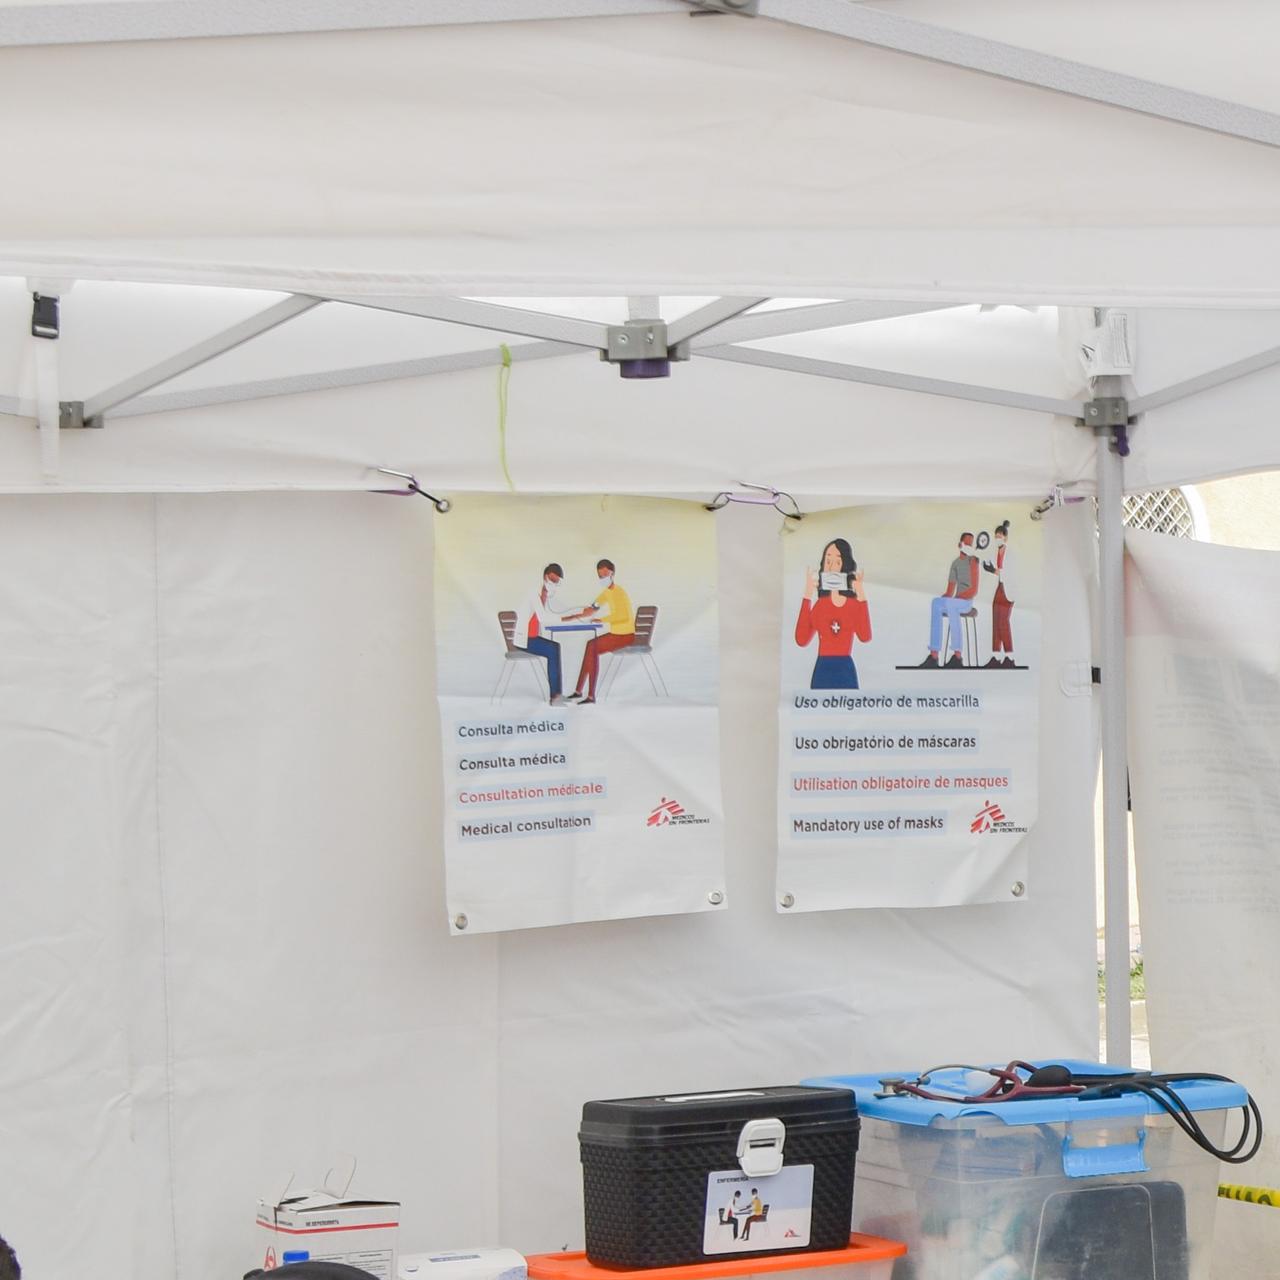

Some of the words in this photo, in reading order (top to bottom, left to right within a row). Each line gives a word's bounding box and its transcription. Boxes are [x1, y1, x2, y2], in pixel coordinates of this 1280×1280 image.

[794, 696, 818, 709] Uso
[822, 695, 893, 710] obligatorio
[896, 695, 912, 708] de
[916, 695, 979, 708] mascarilla
[458, 724, 513, 738] Consulta
[517, 720, 565, 734] médica
[795, 736, 819, 750] Uso
[822, 735, 894, 751] obrigatório
[898, 735, 914, 748] de
[918, 735, 976, 748] máscaras
[459, 757, 515, 771] Consulta
[519, 753, 566, 766] médica
[793, 777, 858, 791] Utilisation
[862, 776, 930, 792] obligatoire
[934, 775, 949, 788] de
[953, 776, 1009, 789] masques
[459, 786, 544, 804] Consultation
[548, 782, 603, 797] médicale
[461, 822, 513, 837] Medical
[516, 816, 592, 832] consultation
[793, 818, 860, 834] Mandatory
[863, 820, 884, 831] use
[888, 816, 901, 829] of
[904, 816, 944, 829] masks
